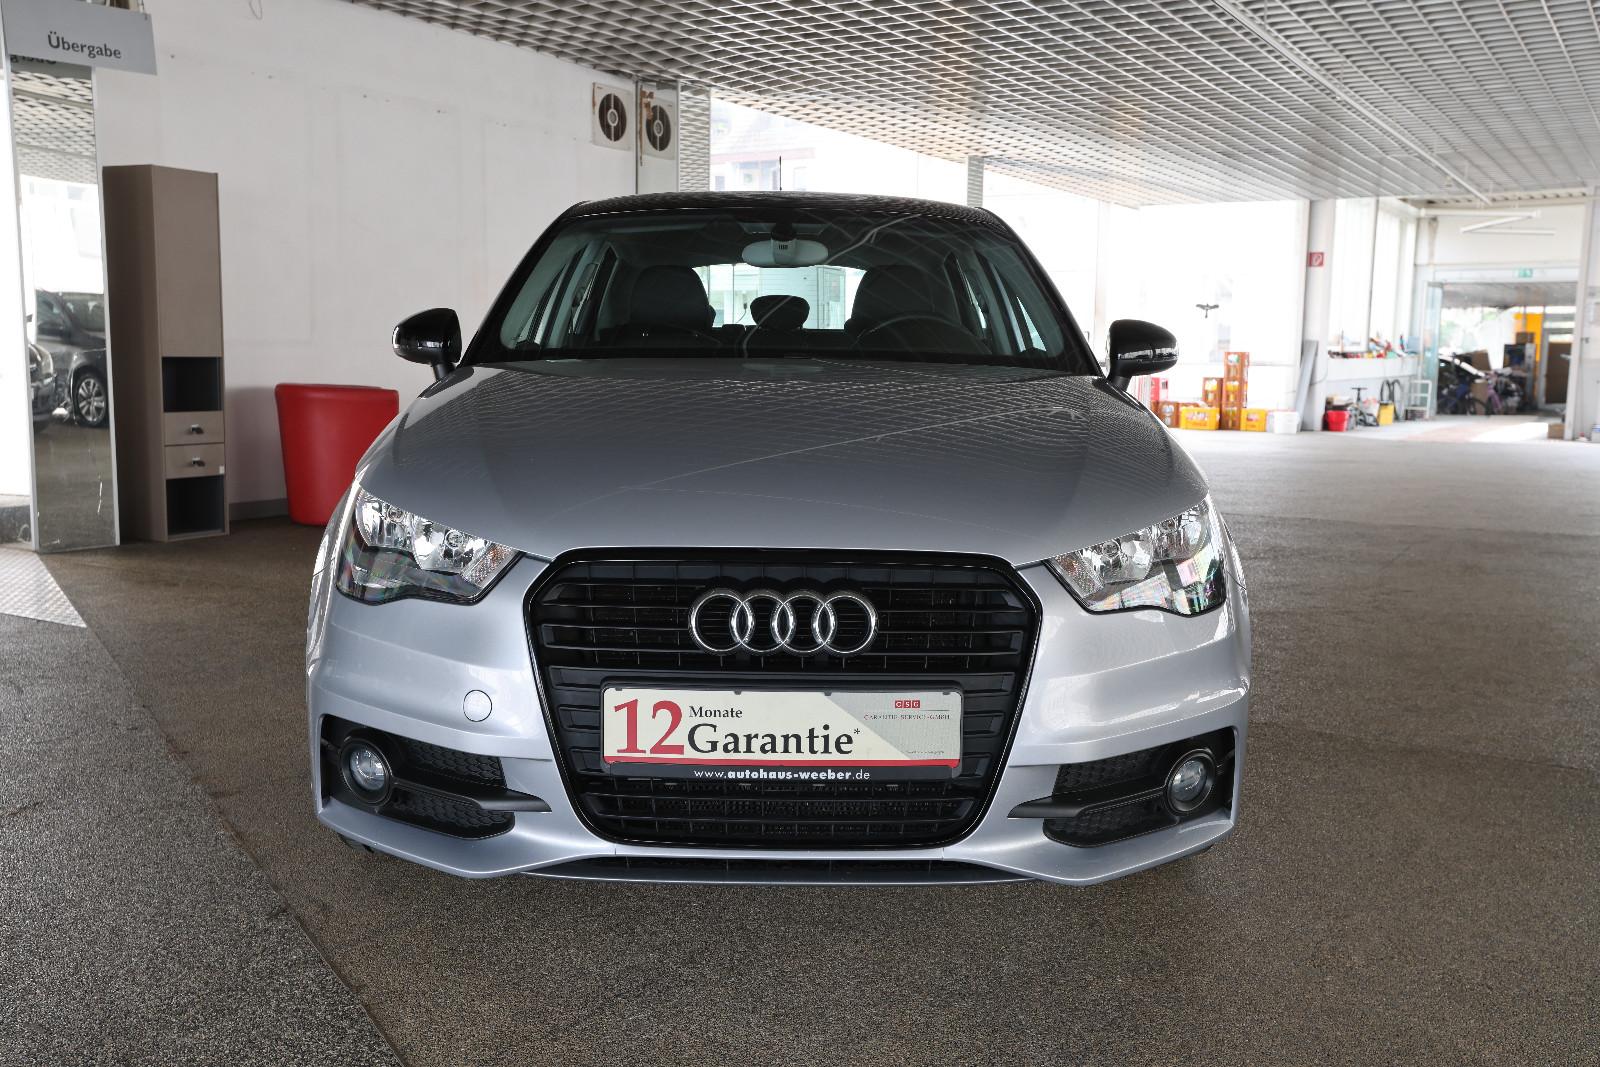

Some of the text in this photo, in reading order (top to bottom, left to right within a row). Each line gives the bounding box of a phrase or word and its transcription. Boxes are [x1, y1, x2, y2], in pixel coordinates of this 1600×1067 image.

[47, 31, 122, 59] Übergabe
[688, 705, 743, 718] Monate
[614, 698, 685, 755] 12
[694, 768, 870, 780] www.autohaus-weeber.de
